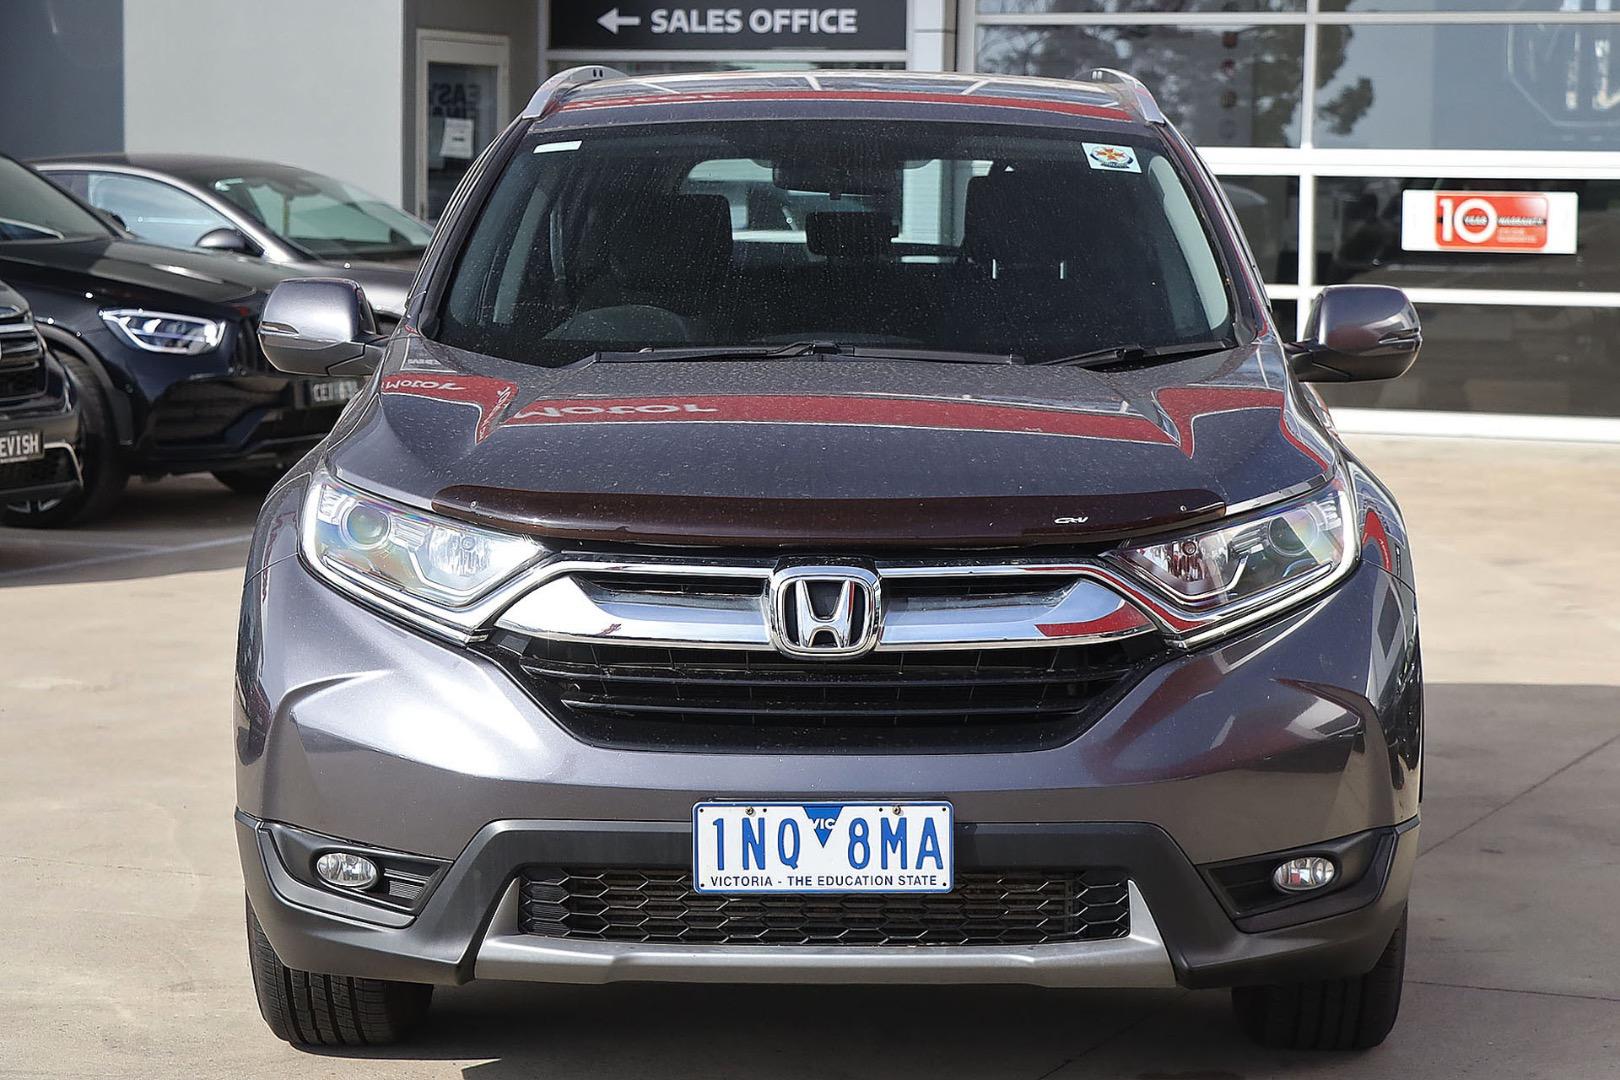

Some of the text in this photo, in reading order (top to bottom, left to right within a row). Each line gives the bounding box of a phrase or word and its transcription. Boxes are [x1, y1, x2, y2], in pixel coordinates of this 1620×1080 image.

[651, 9, 858, 33] SALES OFFICE
[1439, 198, 1497, 243] 10
[712, 817, 944, 871] 1NQ 8MA
[710, 875, 772, 887] VICTORIA
[788, 876, 812, 886] THE
[817, 875, 893, 887] EDUCATION
[898, 875, 937, 886] STATE
